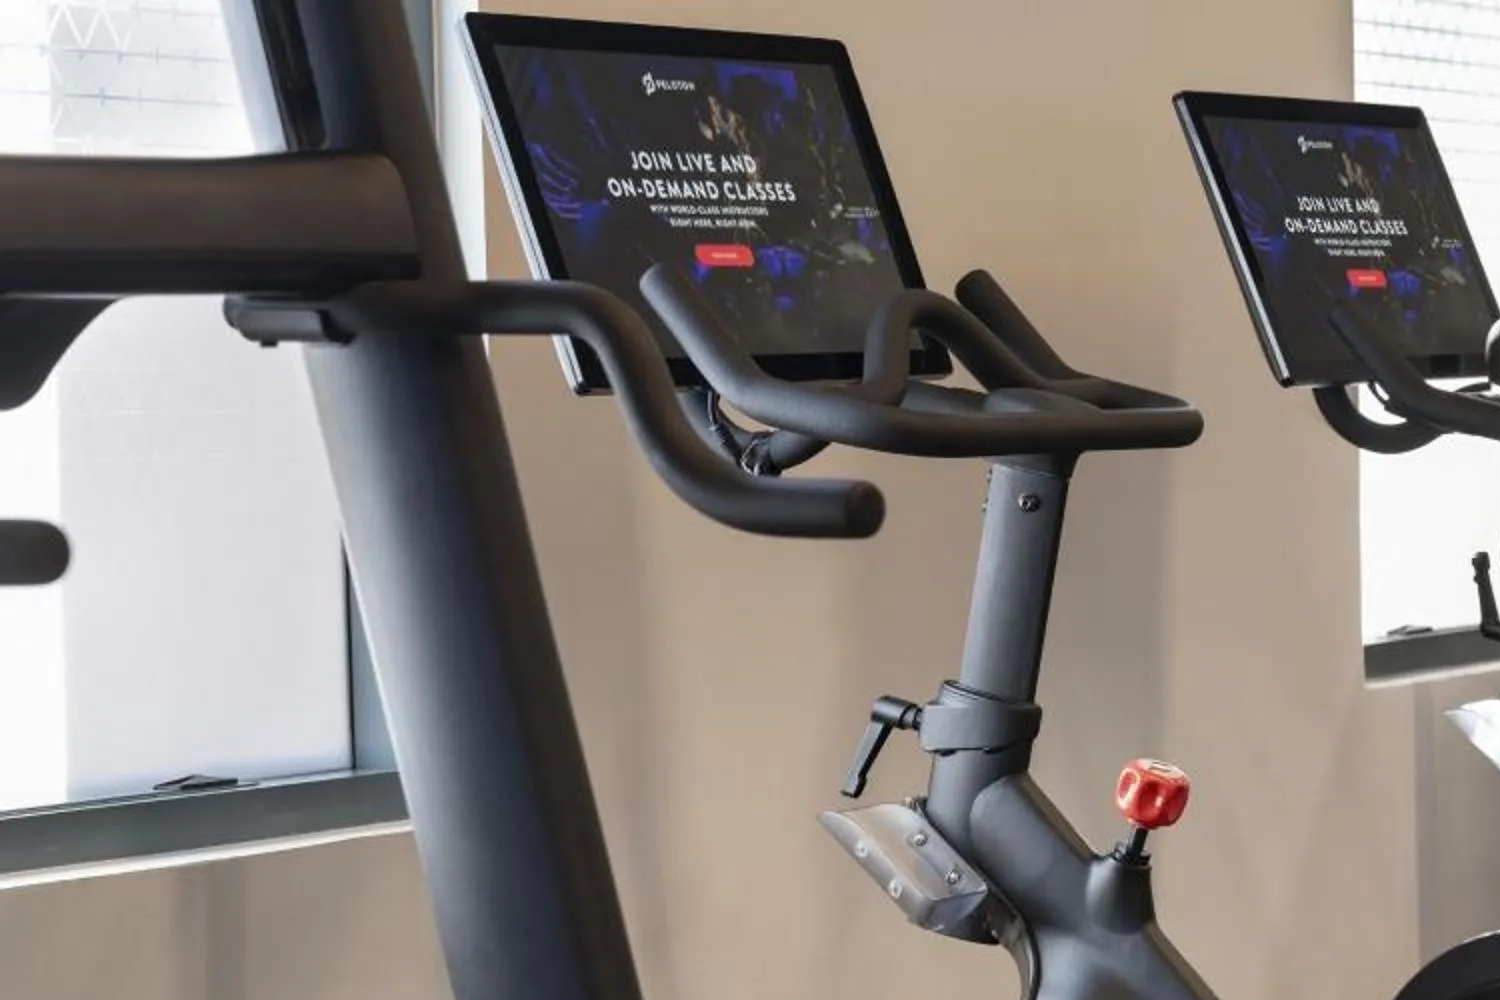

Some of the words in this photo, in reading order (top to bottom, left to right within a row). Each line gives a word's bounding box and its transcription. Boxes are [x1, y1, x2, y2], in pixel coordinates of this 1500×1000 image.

[631, 151, 673, 171] JOIN
[676, 152, 717, 173] LIVE
[721, 154, 757, 174] AND
[607, 177, 719, 199] ON-DEMAND
[723, 181, 796, 202] CLASSES
[1297, 196, 1326, 212] JOIN
[1327, 197, 1354, 213] LIVE
[1355, 198, 1380, 214] AND
[1284, 217, 1358, 235] ON-DEMAND
[1359, 220, 1409, 236] CLASSES
